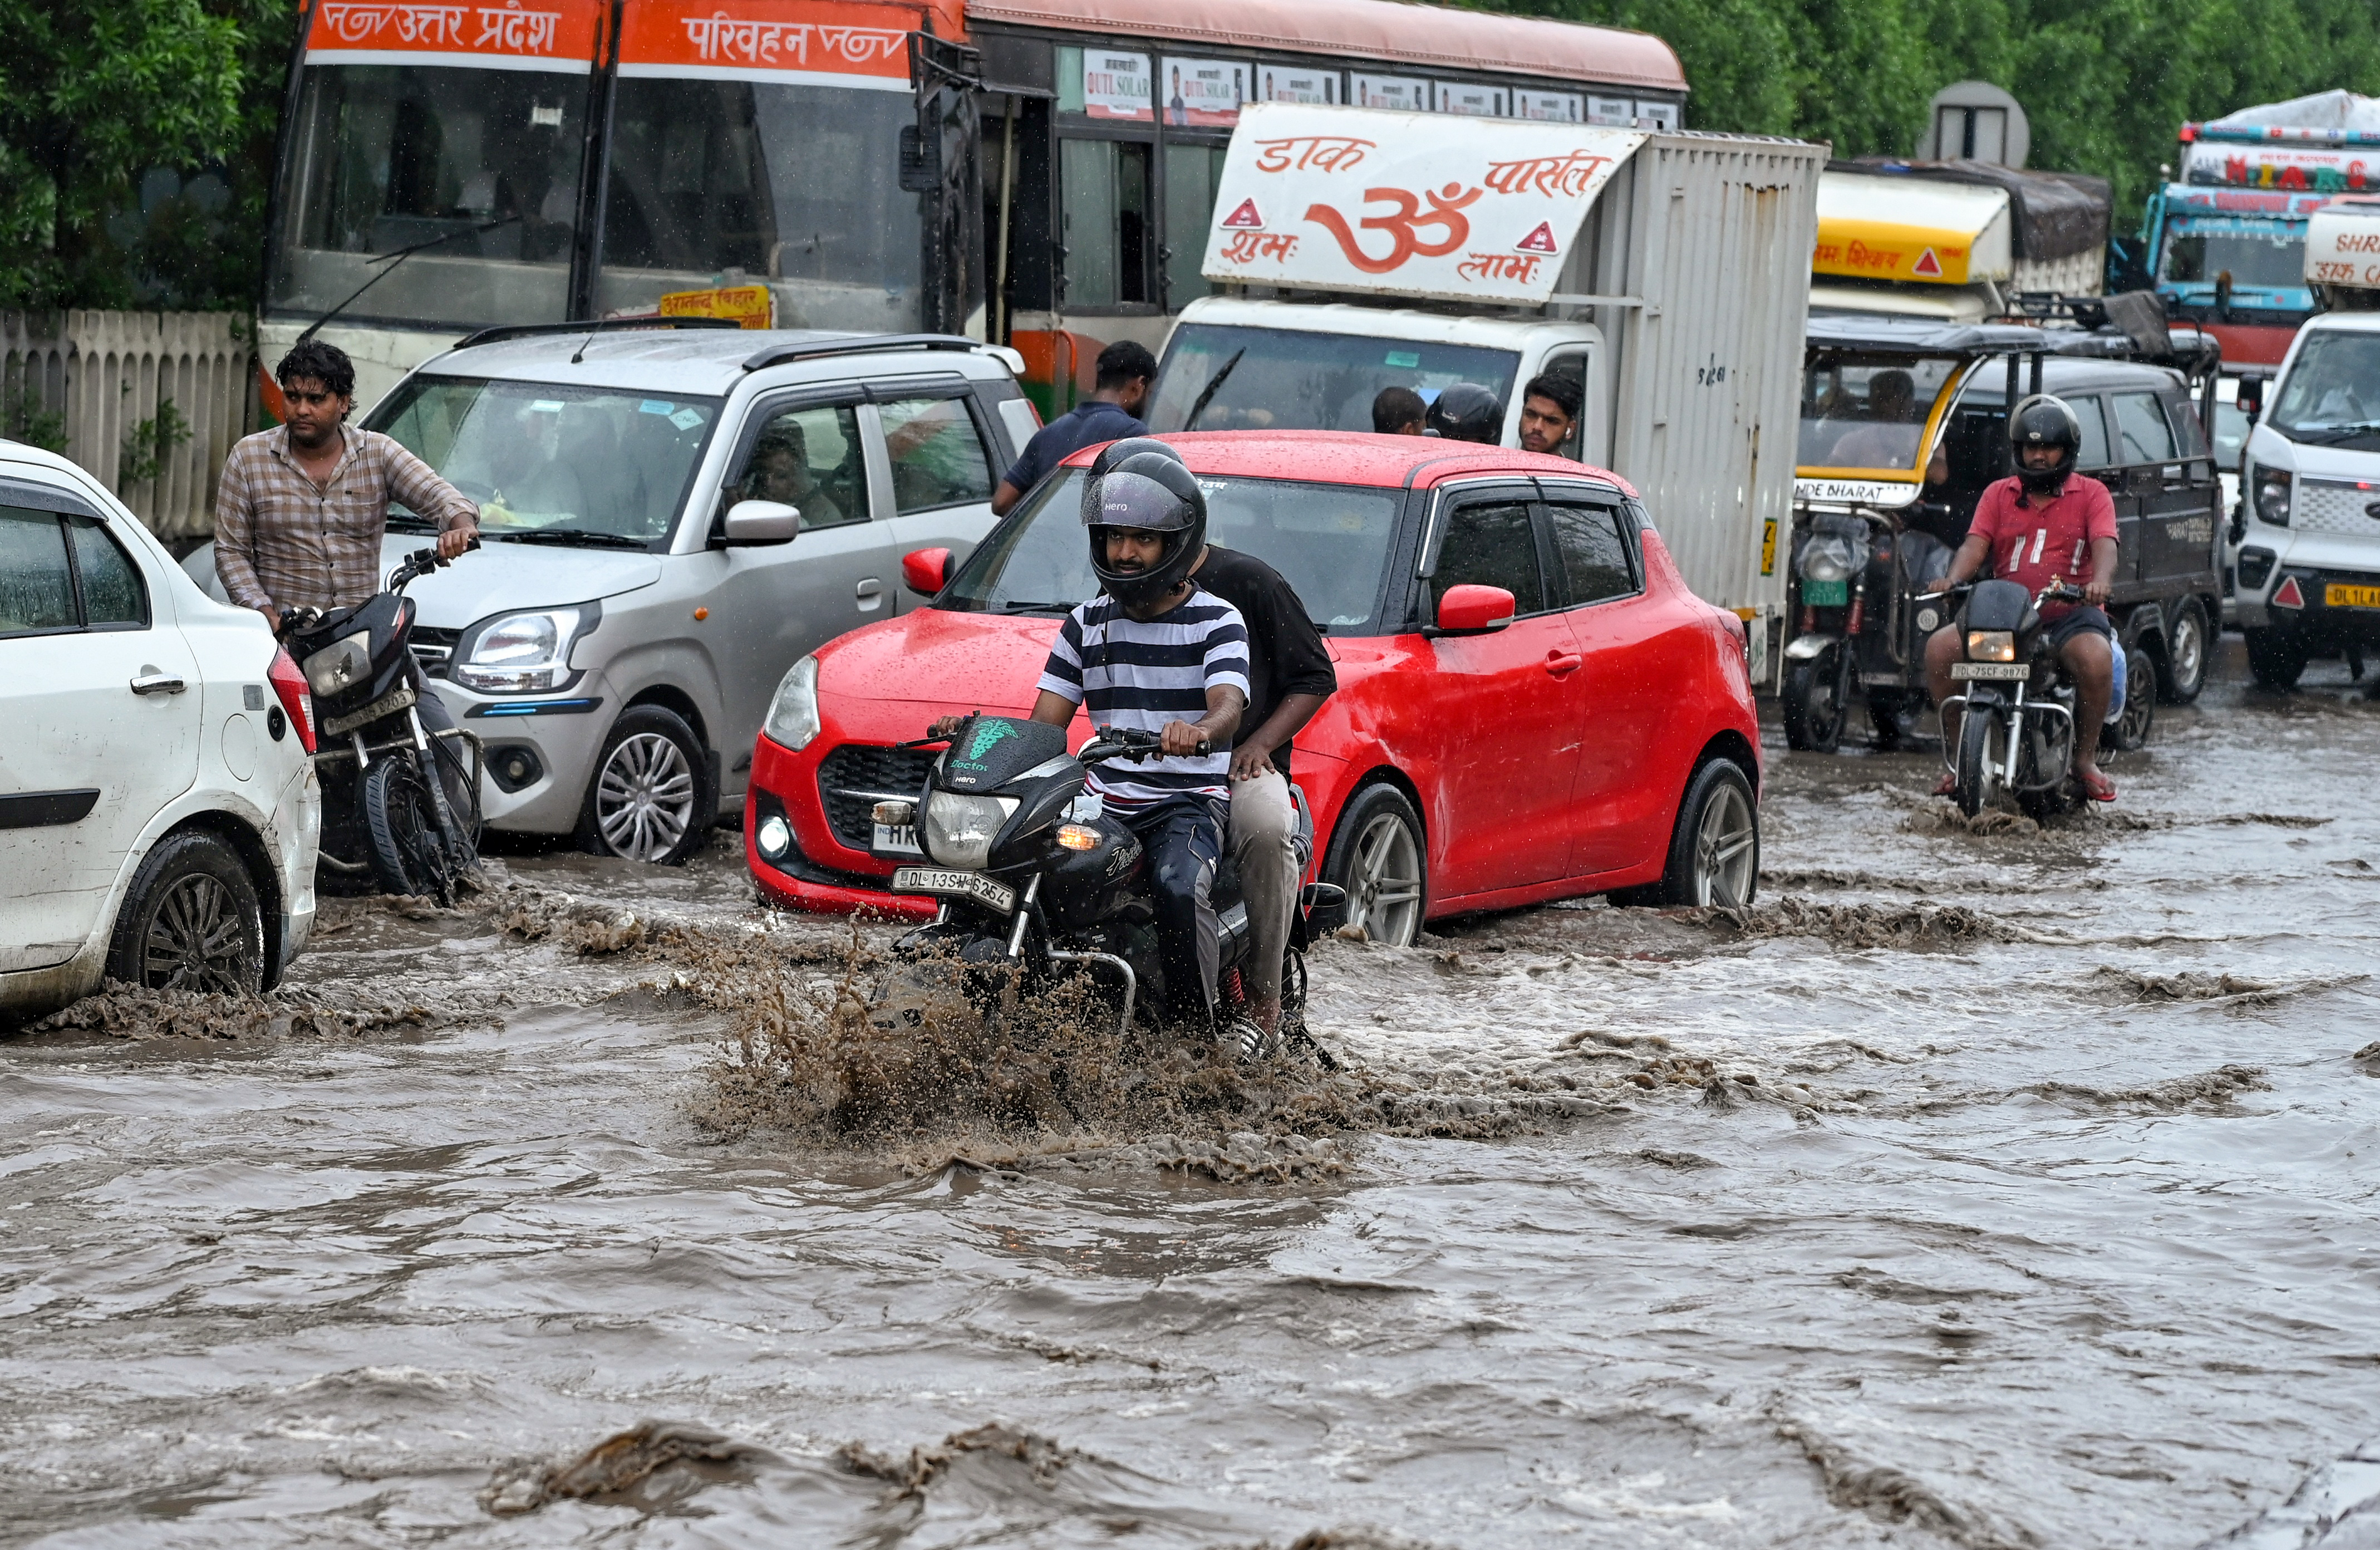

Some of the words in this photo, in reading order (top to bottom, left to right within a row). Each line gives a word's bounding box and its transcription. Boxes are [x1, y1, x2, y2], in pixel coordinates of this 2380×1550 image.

[395, 4, 469, 46] उत्तर
[475, 0, 562, 53] प्रदेश
[681, 11, 815, 64] परिवहन
[1117, 76, 1150, 97] SOLAR
[1255, 136, 1377, 173] डाक
[1484, 149, 1612, 198] पार्सल
[2337, 234, 2380, 252] SHR
[1827, 484, 1884, 499] BHARAT
[1105, 503, 1128, 511] Hero
[951, 759, 988, 772] Doctor
[909, 872, 925, 886] DL
